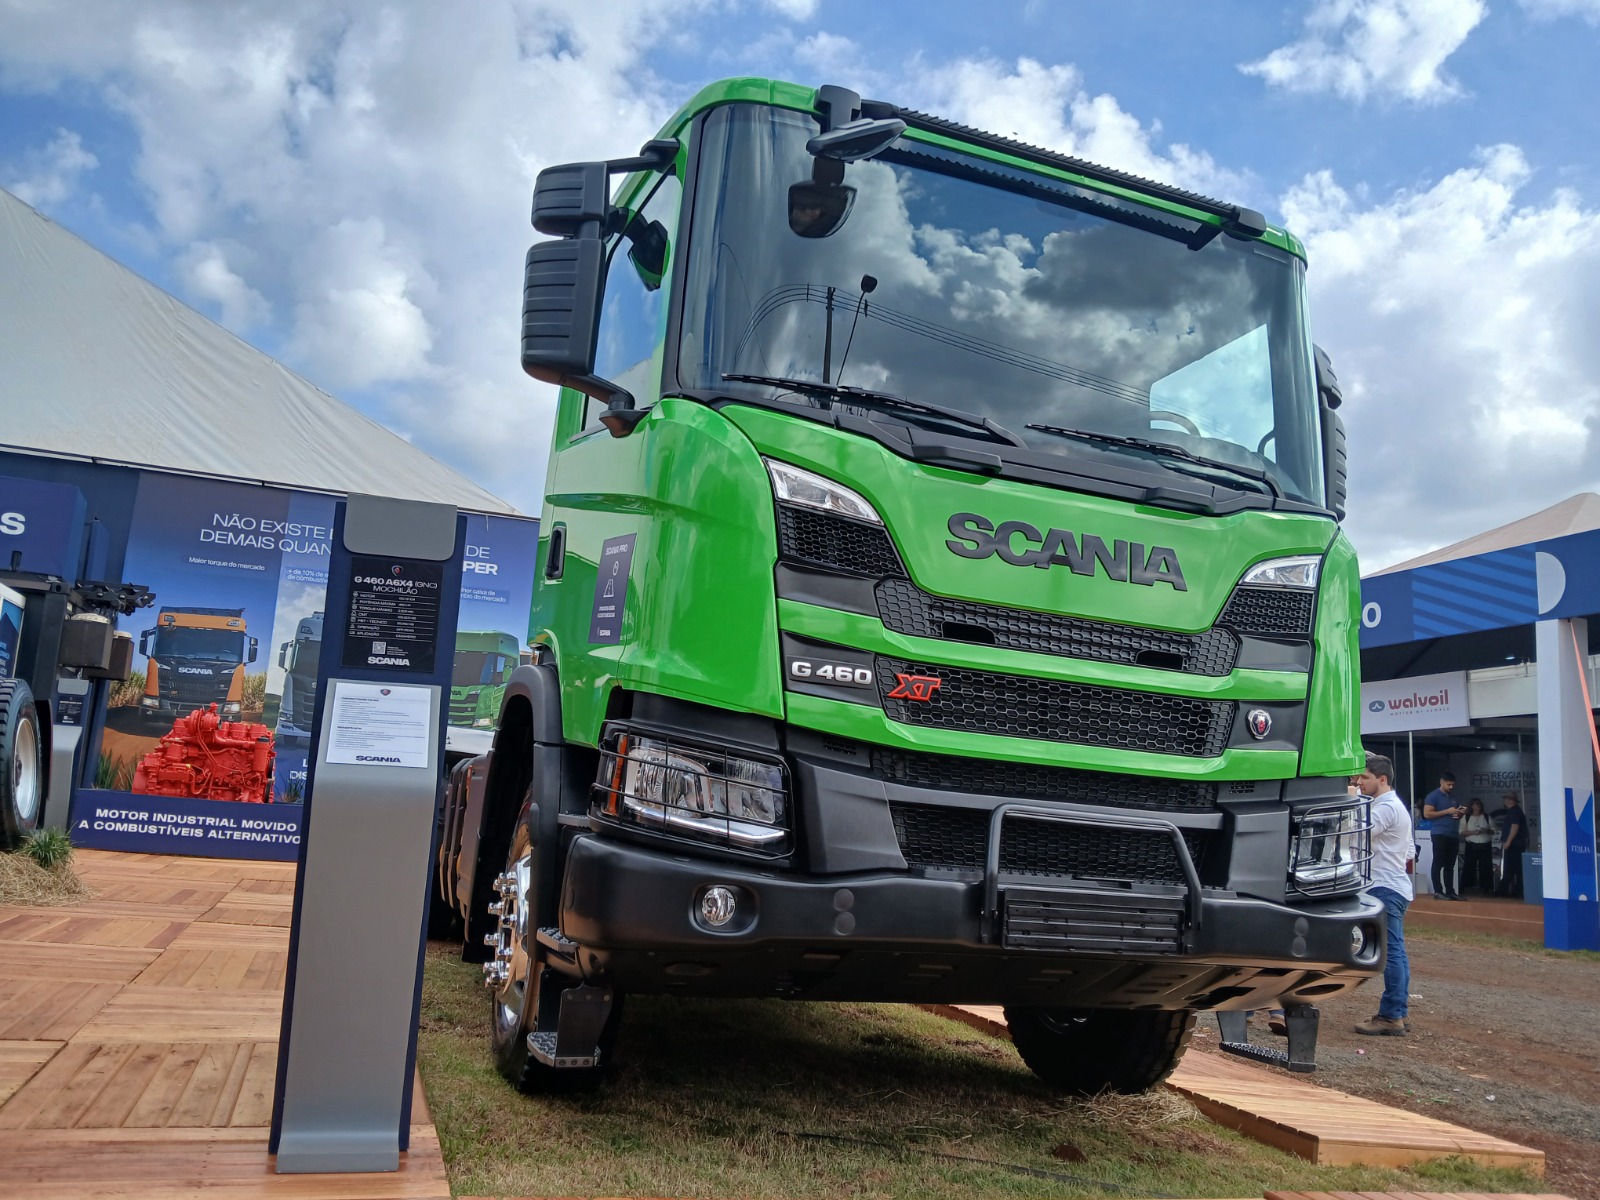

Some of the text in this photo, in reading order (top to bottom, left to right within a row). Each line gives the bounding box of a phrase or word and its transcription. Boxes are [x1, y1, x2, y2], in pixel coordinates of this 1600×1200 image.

[212, 513, 256, 531] NÃO
[260, 519, 325, 539] EXISTE
[200, 528, 275, 550] DEMAIS
[465, 545, 491, 559] DE
[620, 543, 628, 553] PRO
[945, 512, 1188, 592] SCANIA
[207, 559, 228, 567] torque
[237, 563, 265, 571] mercado
[462, 560, 498, 575] PER
[363, 576, 385, 585] 460
[385, 578, 413, 587] A6X4
[373, 585, 418, 595] MOCHILÃO
[481, 595, 507, 603] mercado
[367, 656, 410, 666] SCANIA
[178, 667, 213, 675] SCANIA
[791, 661, 873, 685] G 460
[888, 673, 942, 701] XT
[1388, 689, 1449, 710] walvoil
[355, 755, 401, 763] SCANIA
[1492, 771, 1536, 780] REGGIANA
[95, 808, 297, 832] MOTOR INDUSTRIAL MOVIDO
[78, 819, 89, 829] A
[93, 821, 204, 838] COMBUSTÍVEIS
